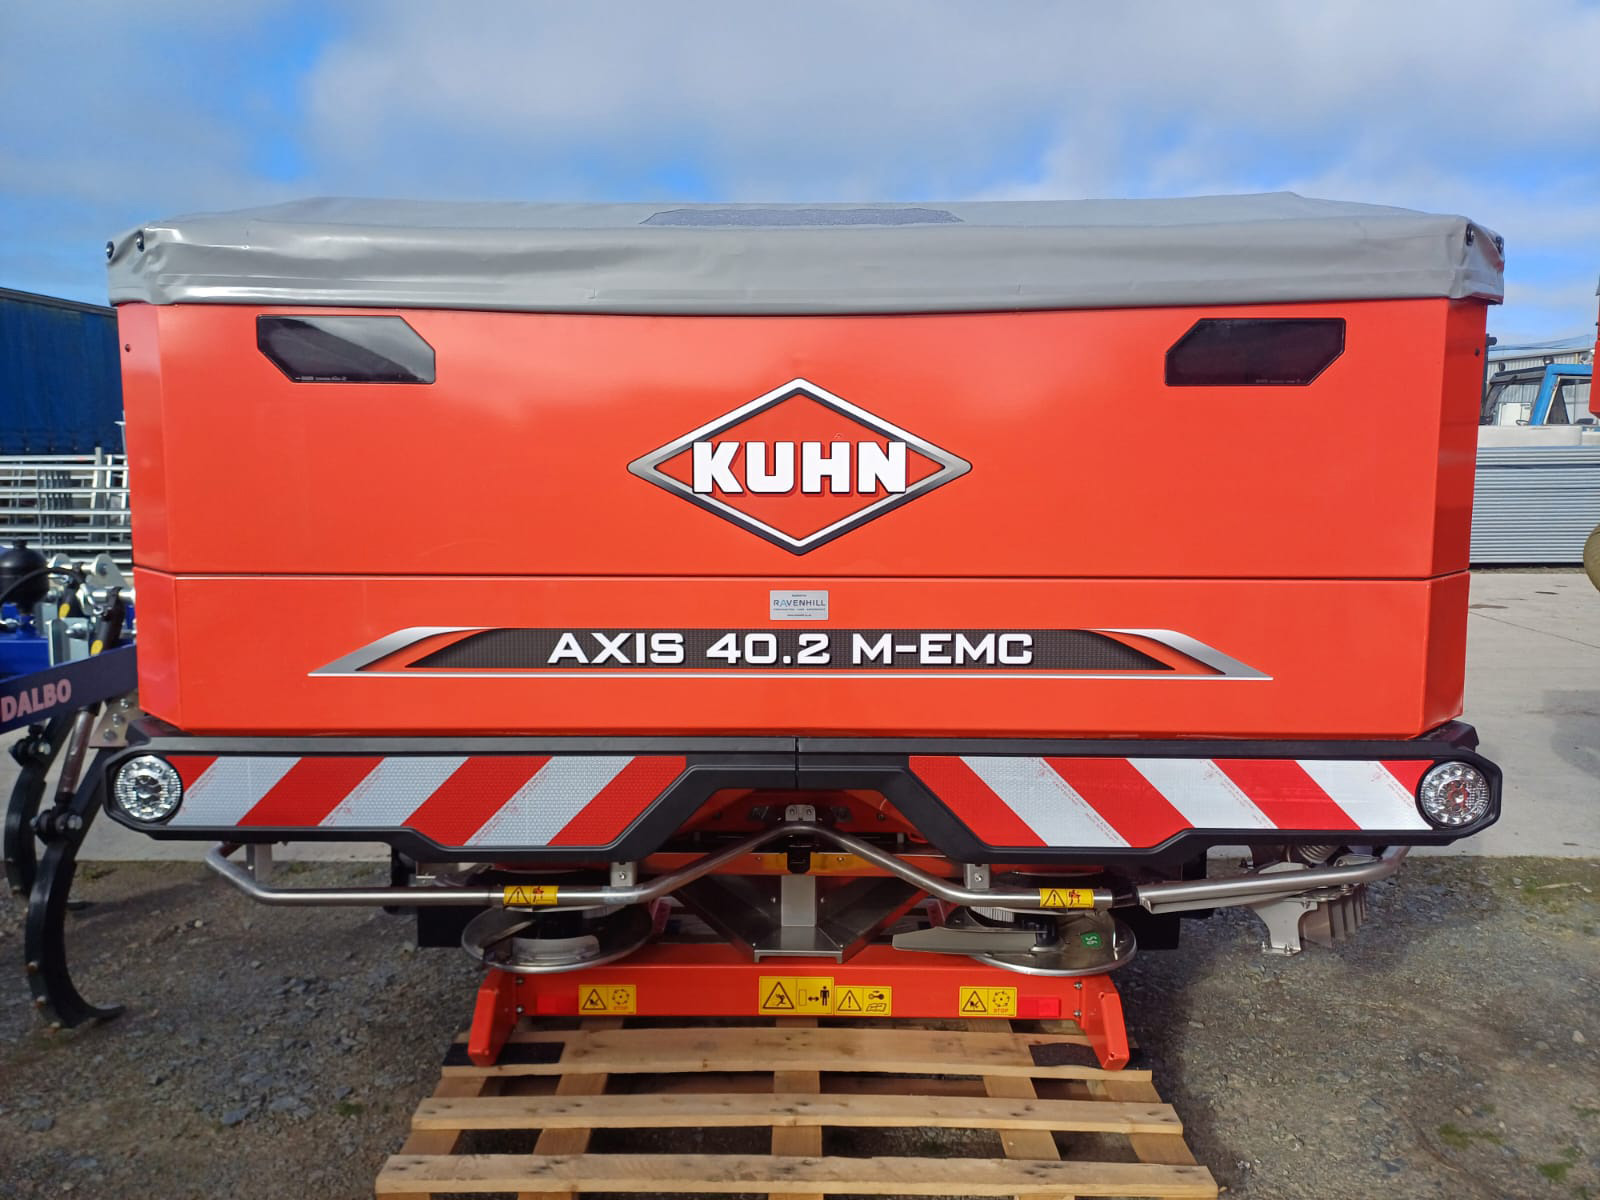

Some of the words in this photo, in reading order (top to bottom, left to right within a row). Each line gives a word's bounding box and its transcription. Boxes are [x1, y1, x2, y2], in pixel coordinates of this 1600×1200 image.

[693, 441, 907, 493] KUHN
[773, 599, 826, 607] RAVENHILL
[547, 632, 685, 665] AXIS
[706, 633, 831, 665] 40.2
[852, 633, 1034, 665] M-EMC
[0, 679, 72, 722] DALBO
